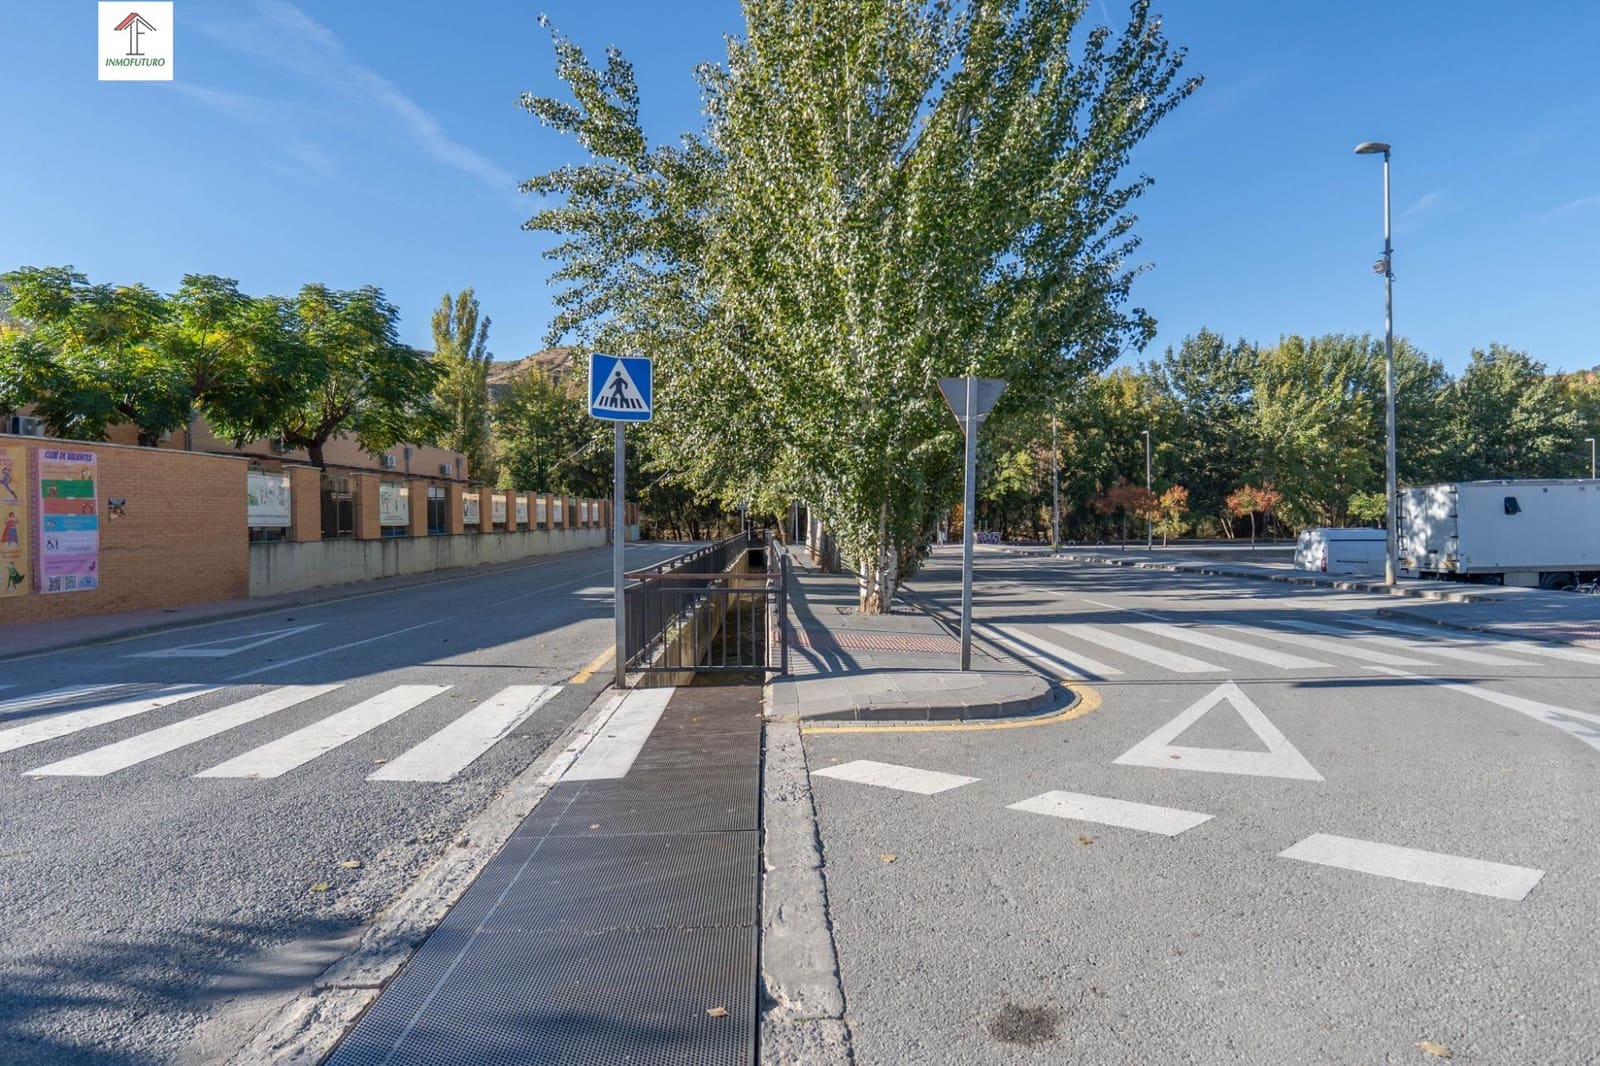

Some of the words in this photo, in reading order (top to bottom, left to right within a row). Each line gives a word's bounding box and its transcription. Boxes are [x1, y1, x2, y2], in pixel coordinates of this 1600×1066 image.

[45, 450, 59, 459] CLUB
[59, 451, 66, 460] DE
[67, 452, 93, 462] VALIENTES
